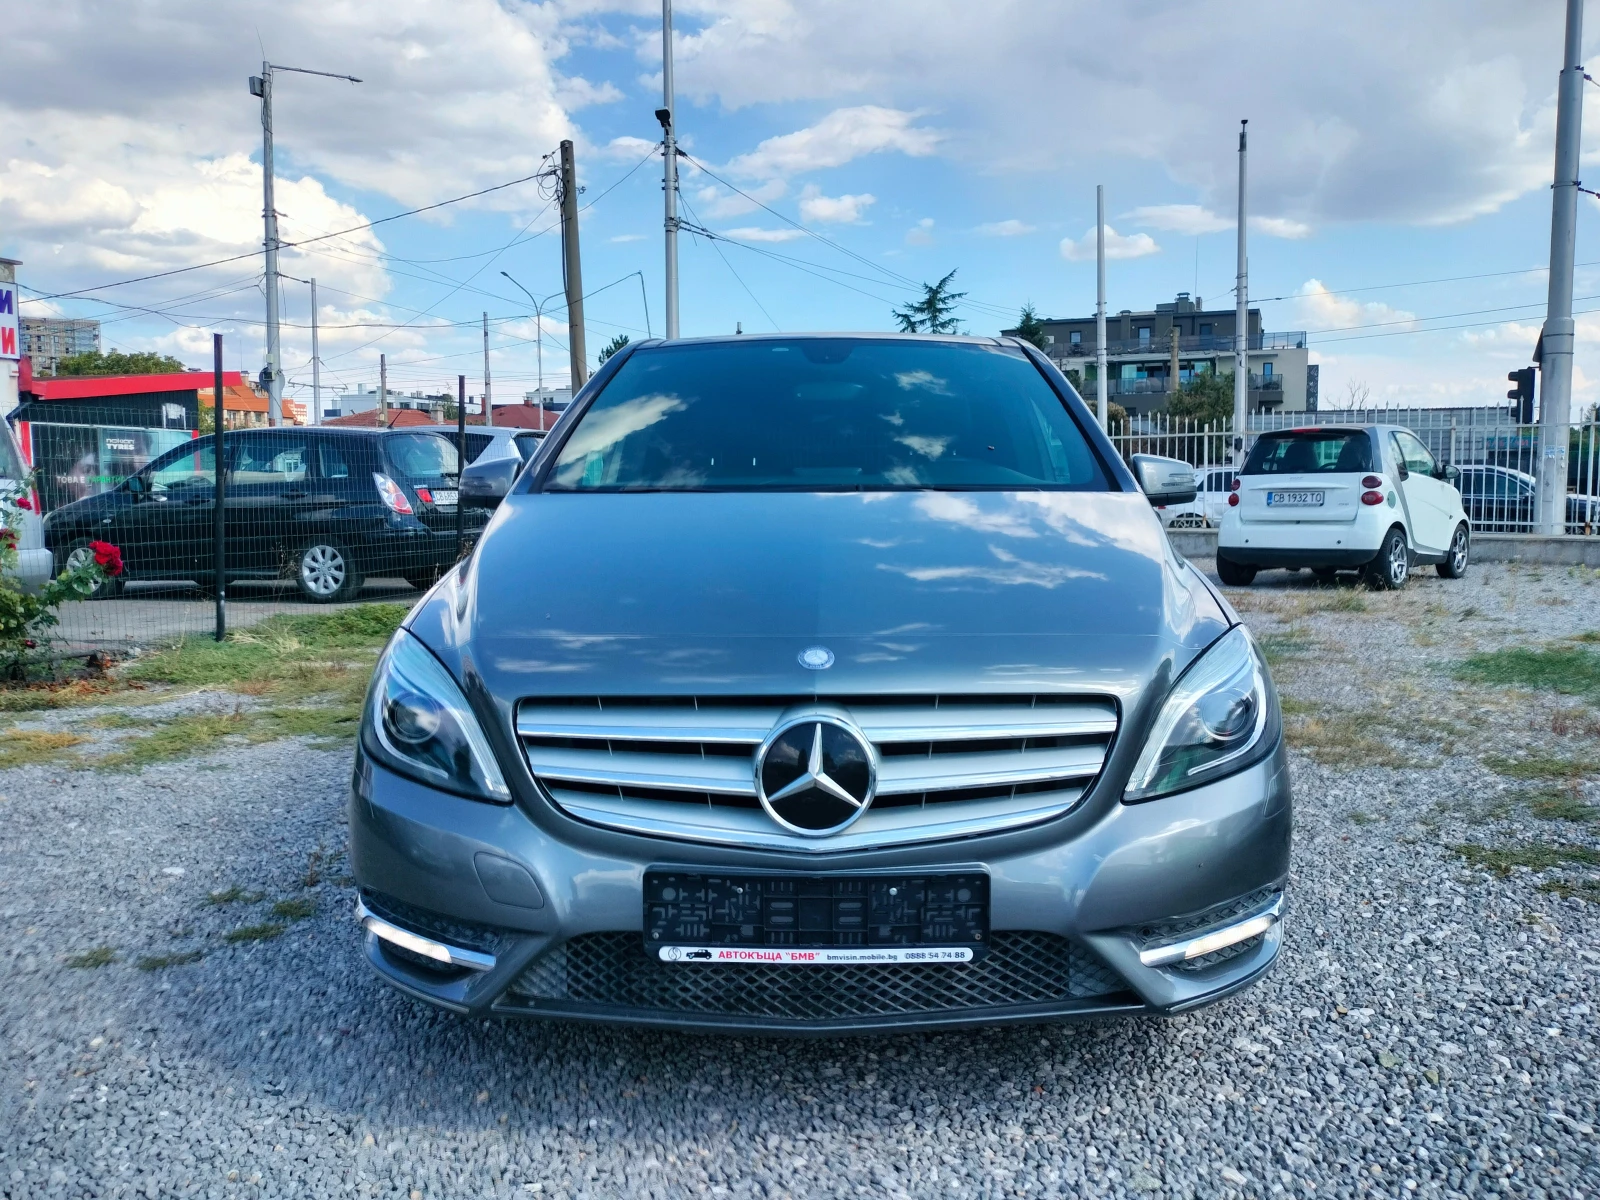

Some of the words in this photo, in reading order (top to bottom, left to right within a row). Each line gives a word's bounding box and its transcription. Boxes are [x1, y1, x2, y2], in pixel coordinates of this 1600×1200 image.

[1287, 493, 1308, 503] 1932
[718, 950, 783, 962] АВТОКЪЩА
[827, 953, 898, 962] bmvisin.mobile.bg
[928, 952, 940, 960] 54
[941, 951, 953, 959] 74
[954, 951, 966, 959] 88
